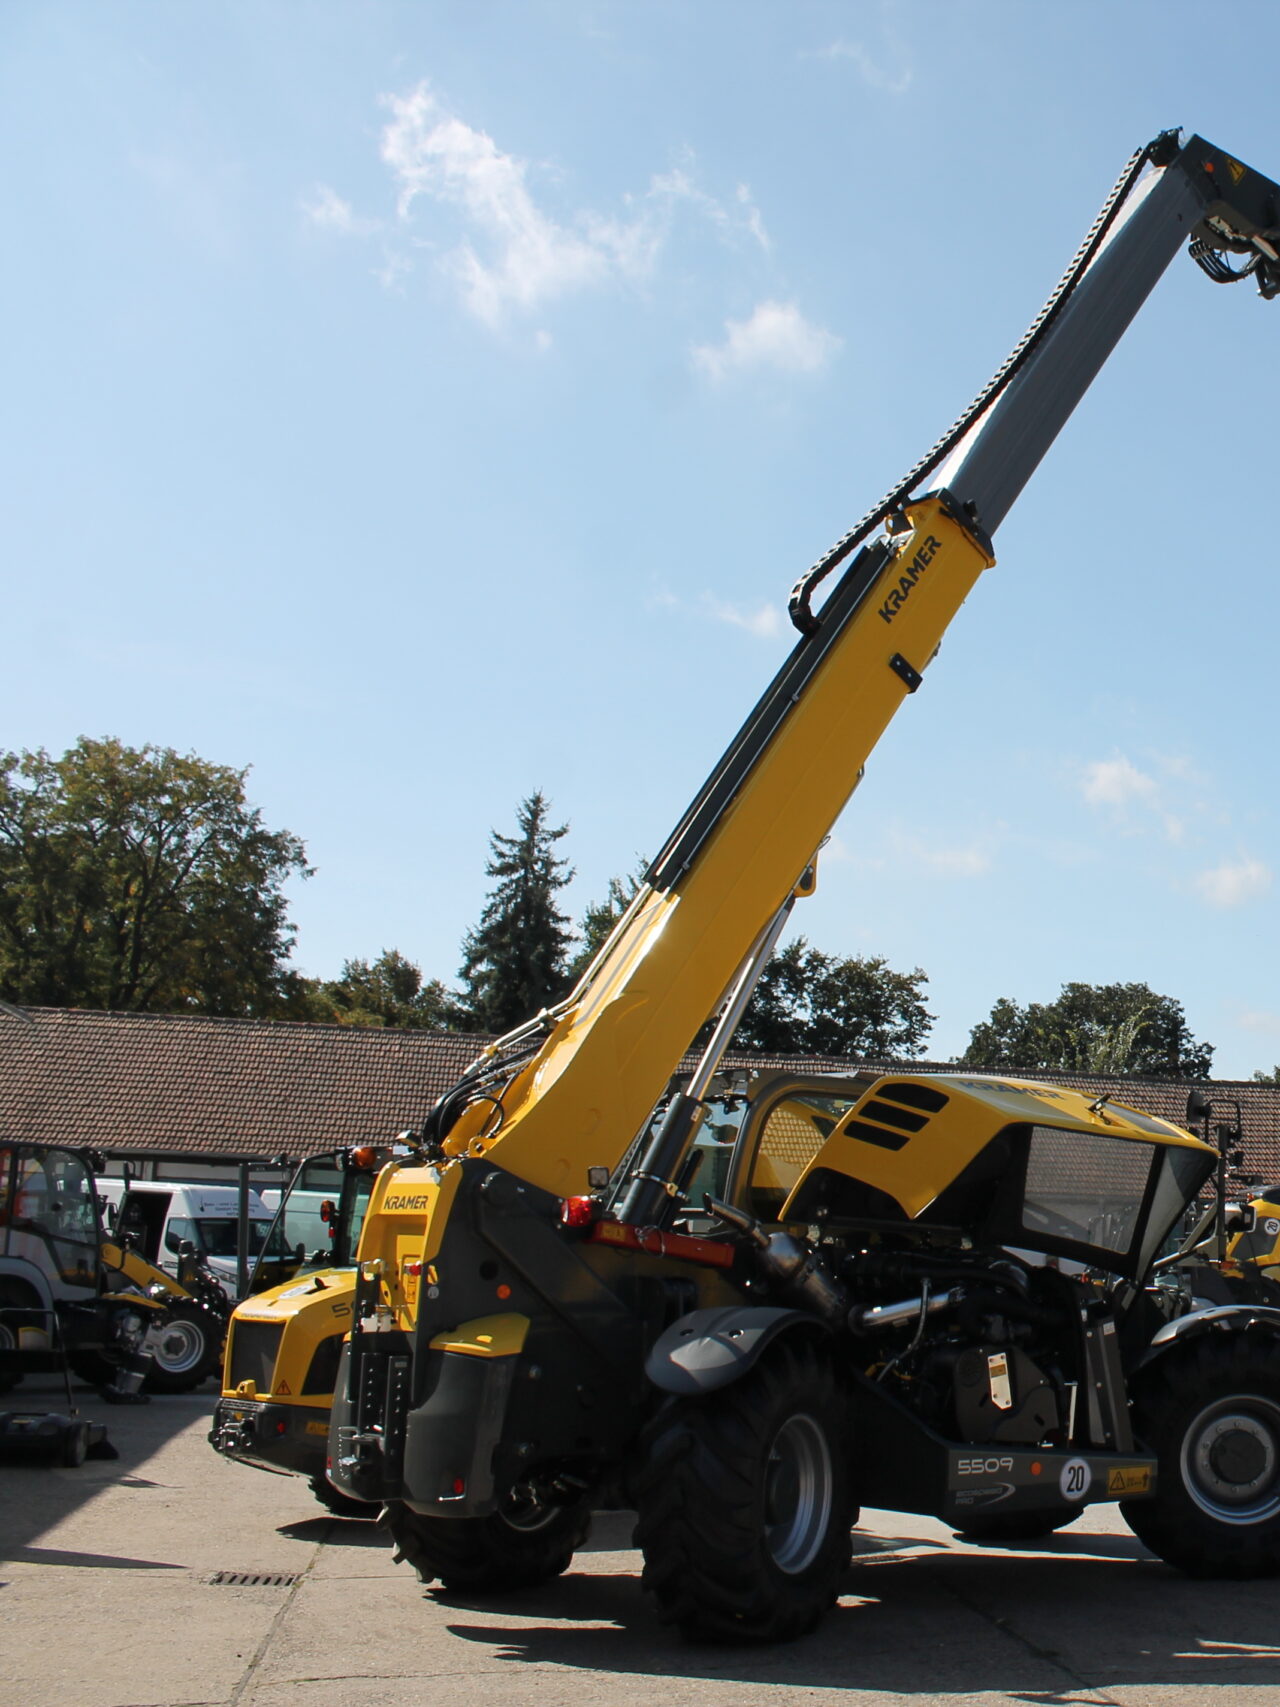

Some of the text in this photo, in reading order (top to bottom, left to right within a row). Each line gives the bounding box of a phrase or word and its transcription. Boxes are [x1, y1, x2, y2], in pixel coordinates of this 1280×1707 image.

[878, 535, 942, 624] KRAMER
[384, 1195, 428, 1210] KRAMER
[957, 1456, 1014, 1475] 5509
[1066, 1465, 1085, 1494] 20
